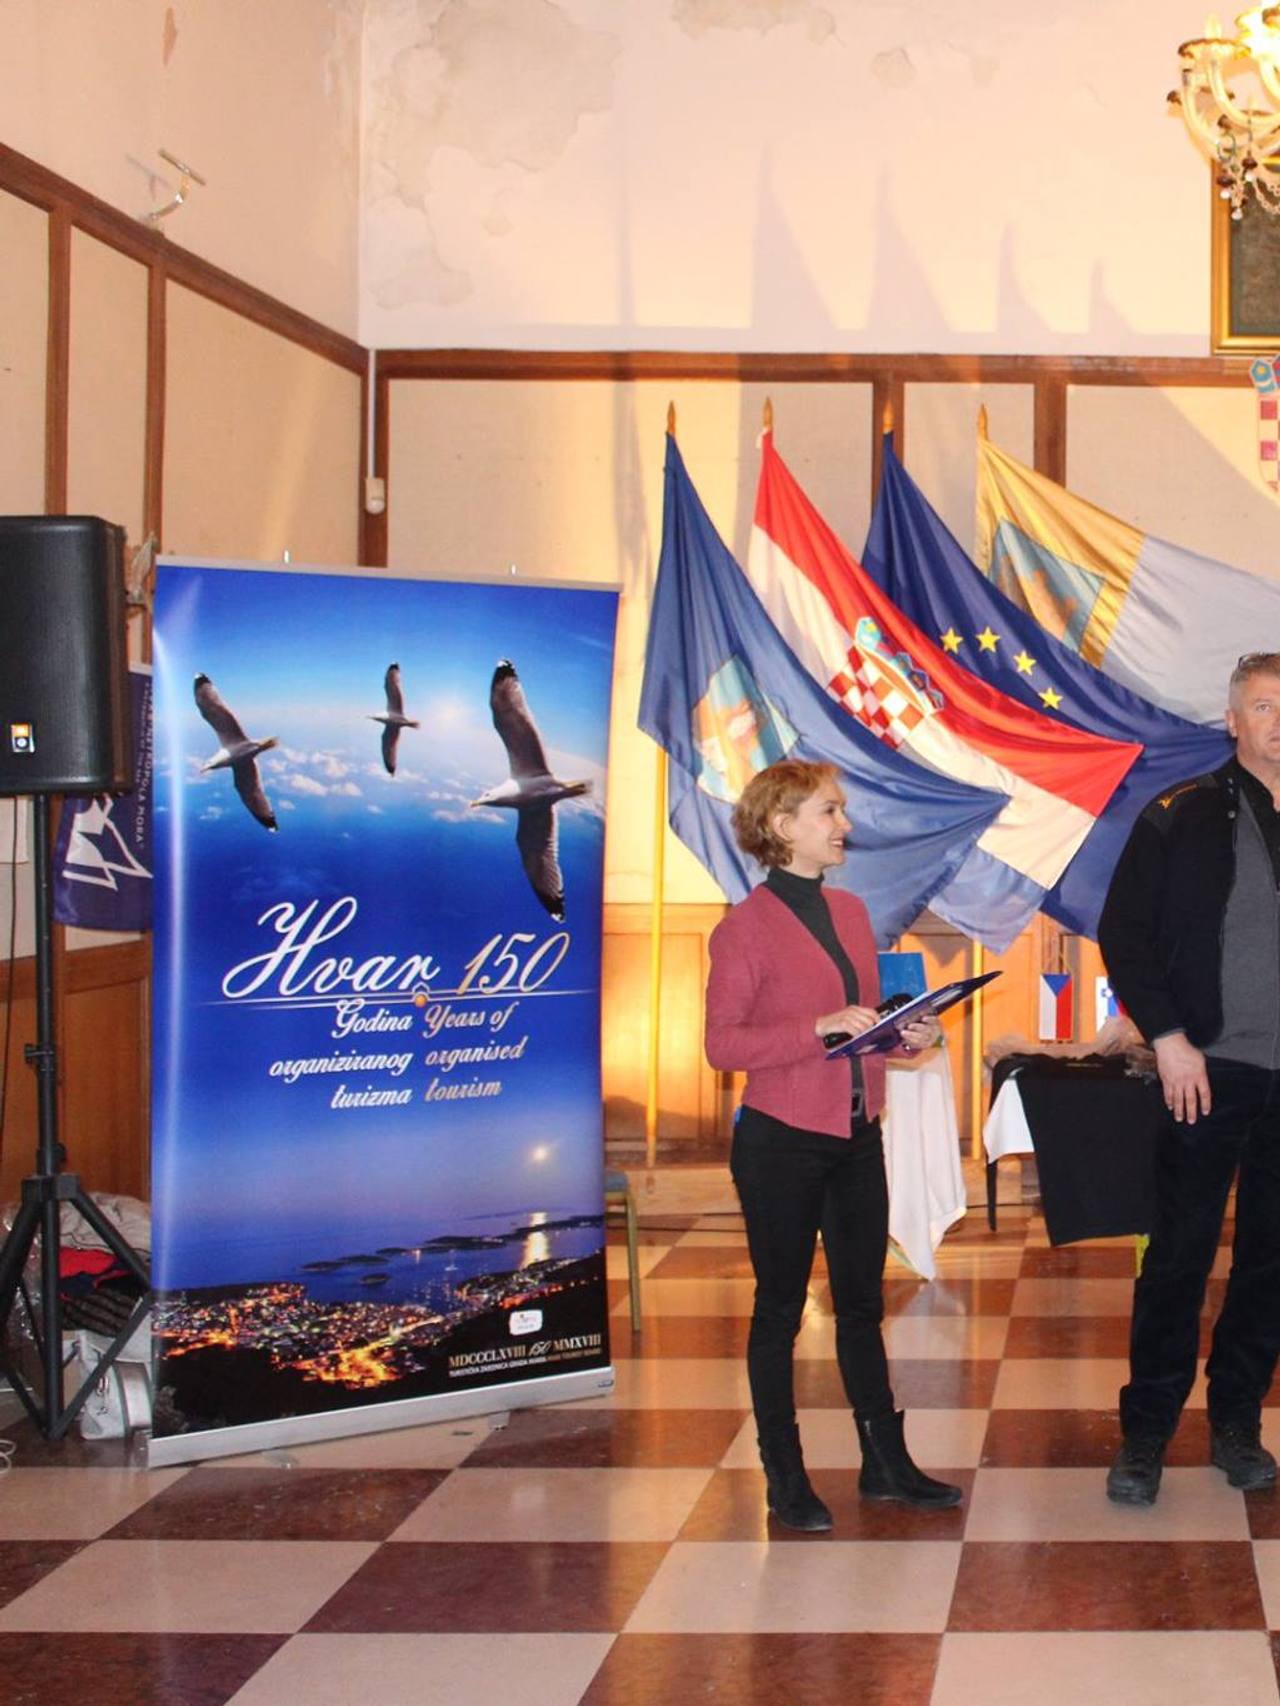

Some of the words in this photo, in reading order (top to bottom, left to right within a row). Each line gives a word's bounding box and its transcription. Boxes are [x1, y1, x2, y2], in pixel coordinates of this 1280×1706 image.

[222, 896, 440, 998] Hvar
[456, 932, 570, 995] 150
[331, 998, 412, 1038] Godina
[422, 1004, 485, 1039] Years
[490, 1001, 520, 1032] of
[269, 1049, 413, 1083] organiziranog
[424, 1035, 529, 1072] organised
[330, 1084, 413, 1109] turizma
[424, 1077, 502, 1102] tourism
[449, 1345, 526, 1368] MDCCCLXVIII
[553, 1333, 601, 1350] MMXVIII
